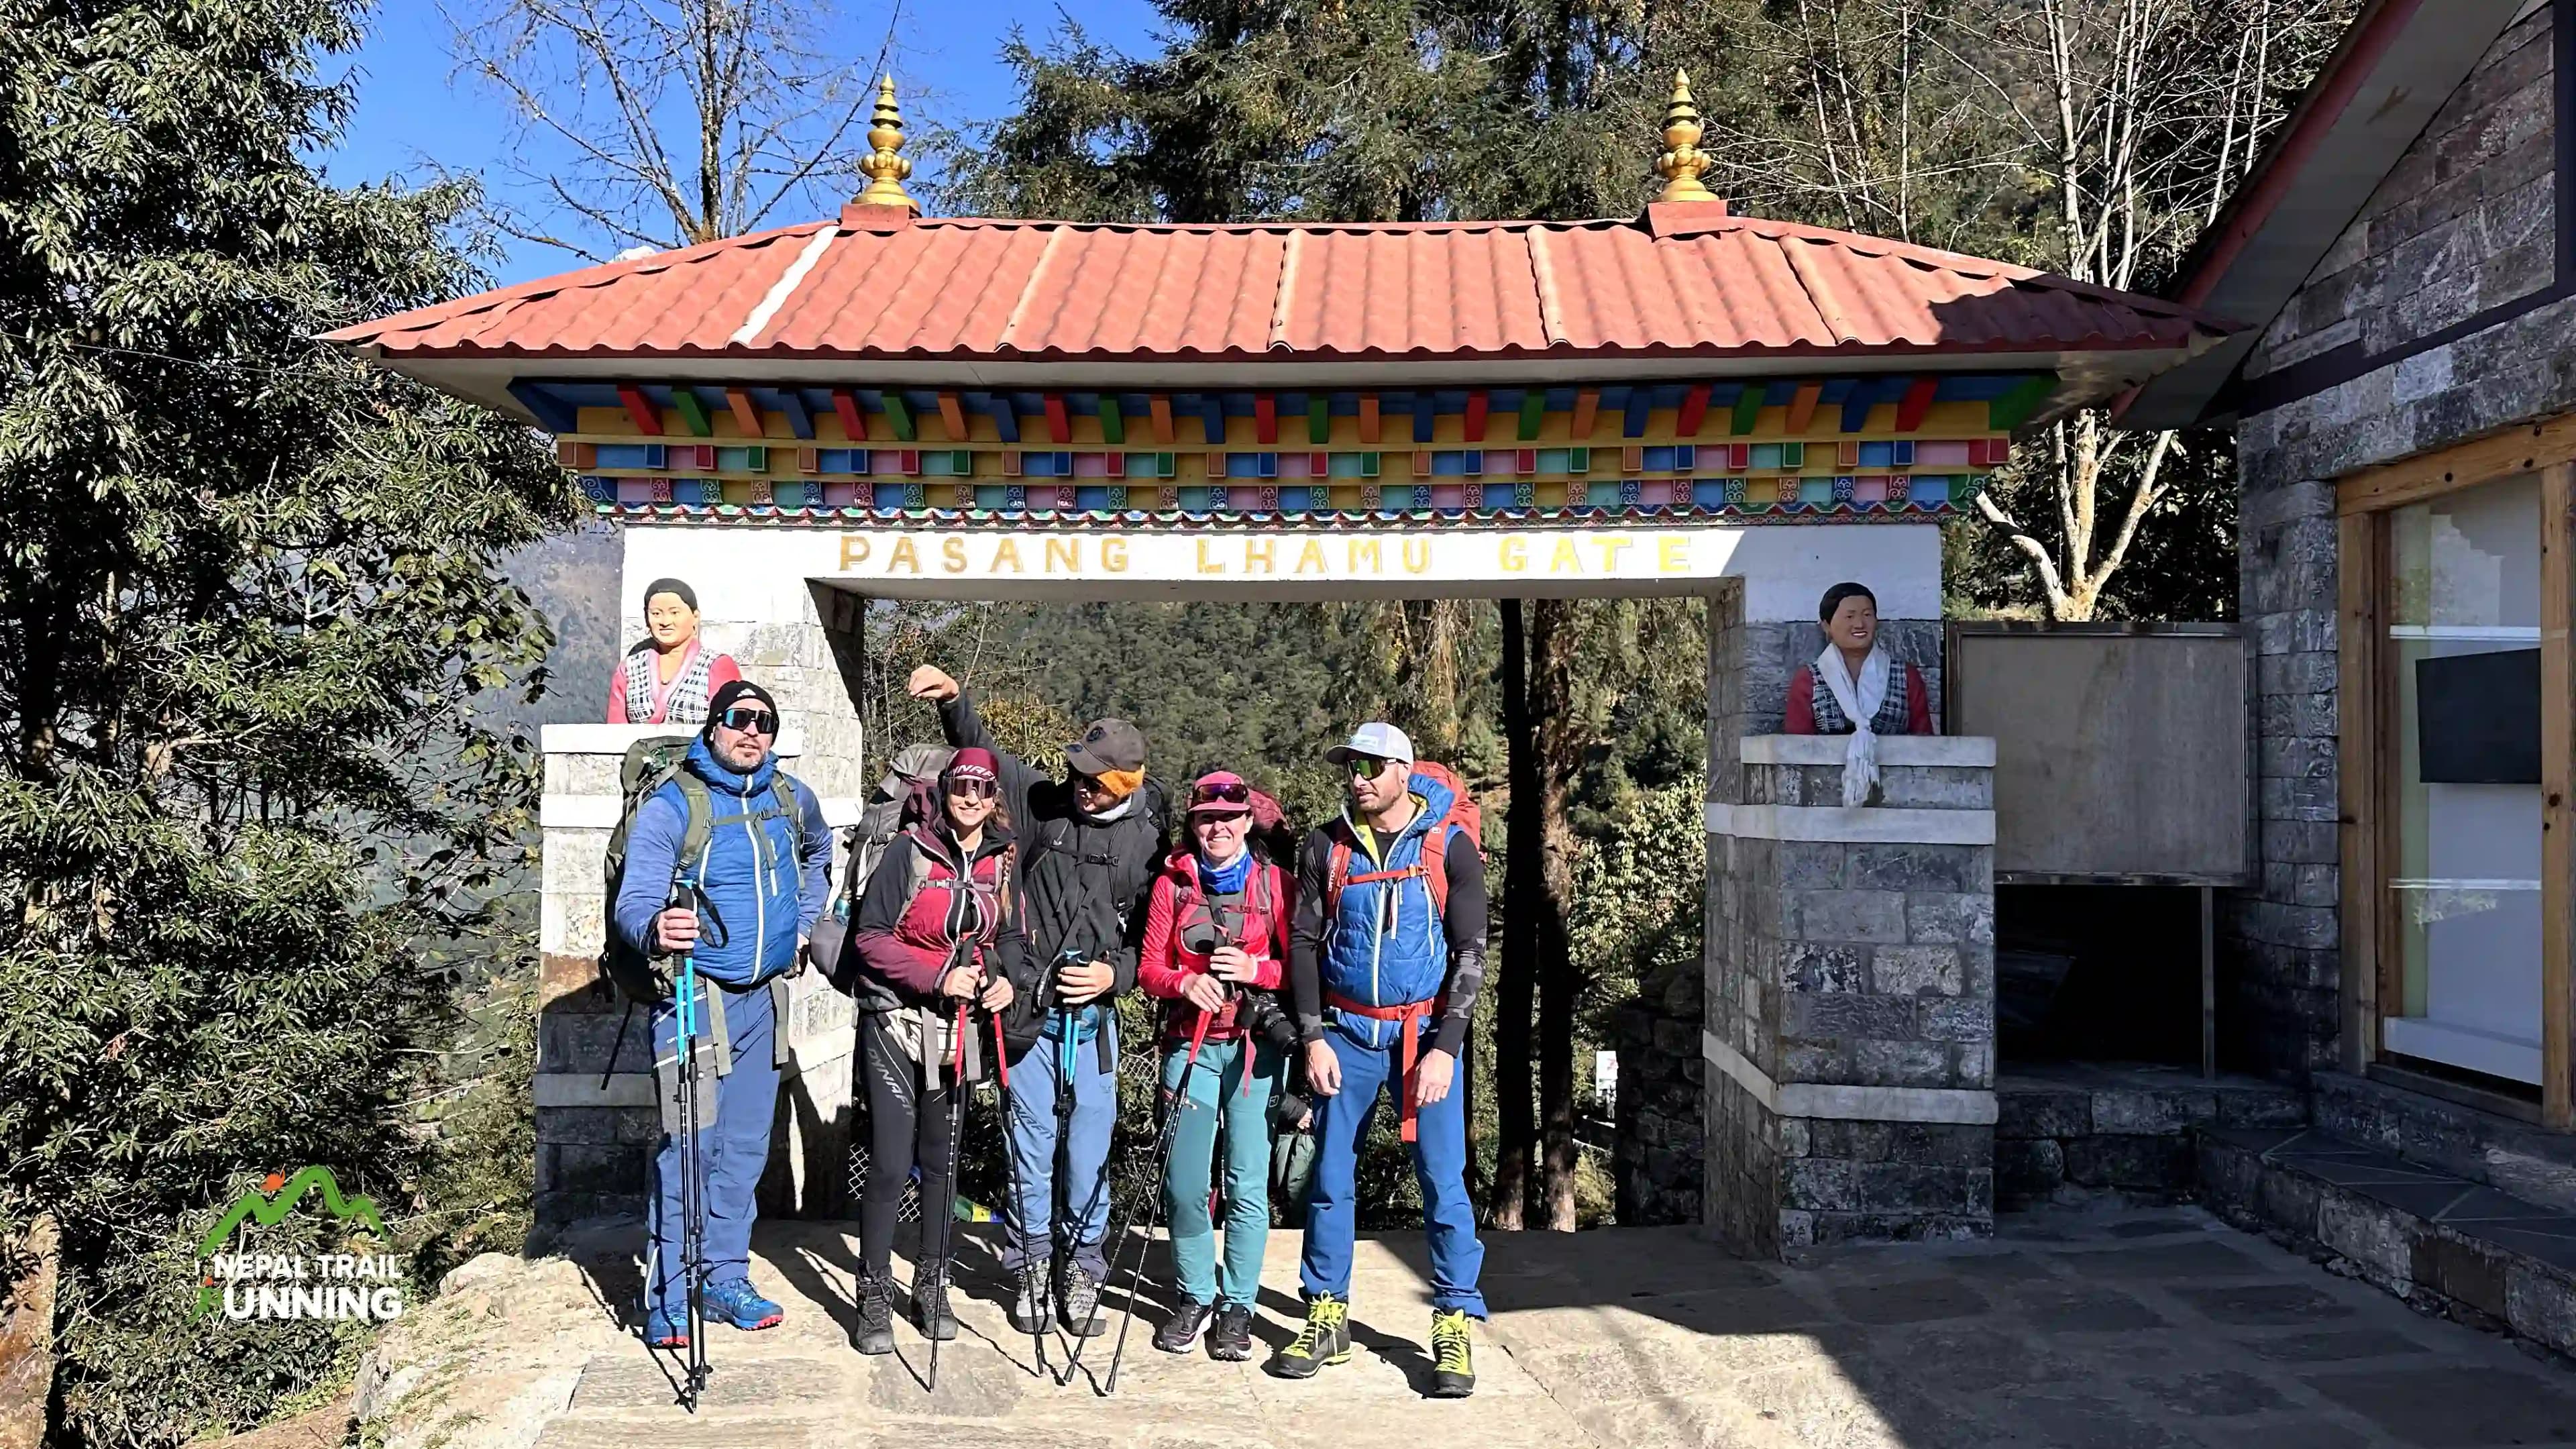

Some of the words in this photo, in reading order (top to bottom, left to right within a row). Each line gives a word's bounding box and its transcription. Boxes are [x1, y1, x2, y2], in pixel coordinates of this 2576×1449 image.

[839, 536, 1130, 574] PASANG
[1196, 538, 1433, 574] LHAMU
[1498, 536, 1691, 573] GATE
[867, 1047, 916, 1119] DYNAFIT
